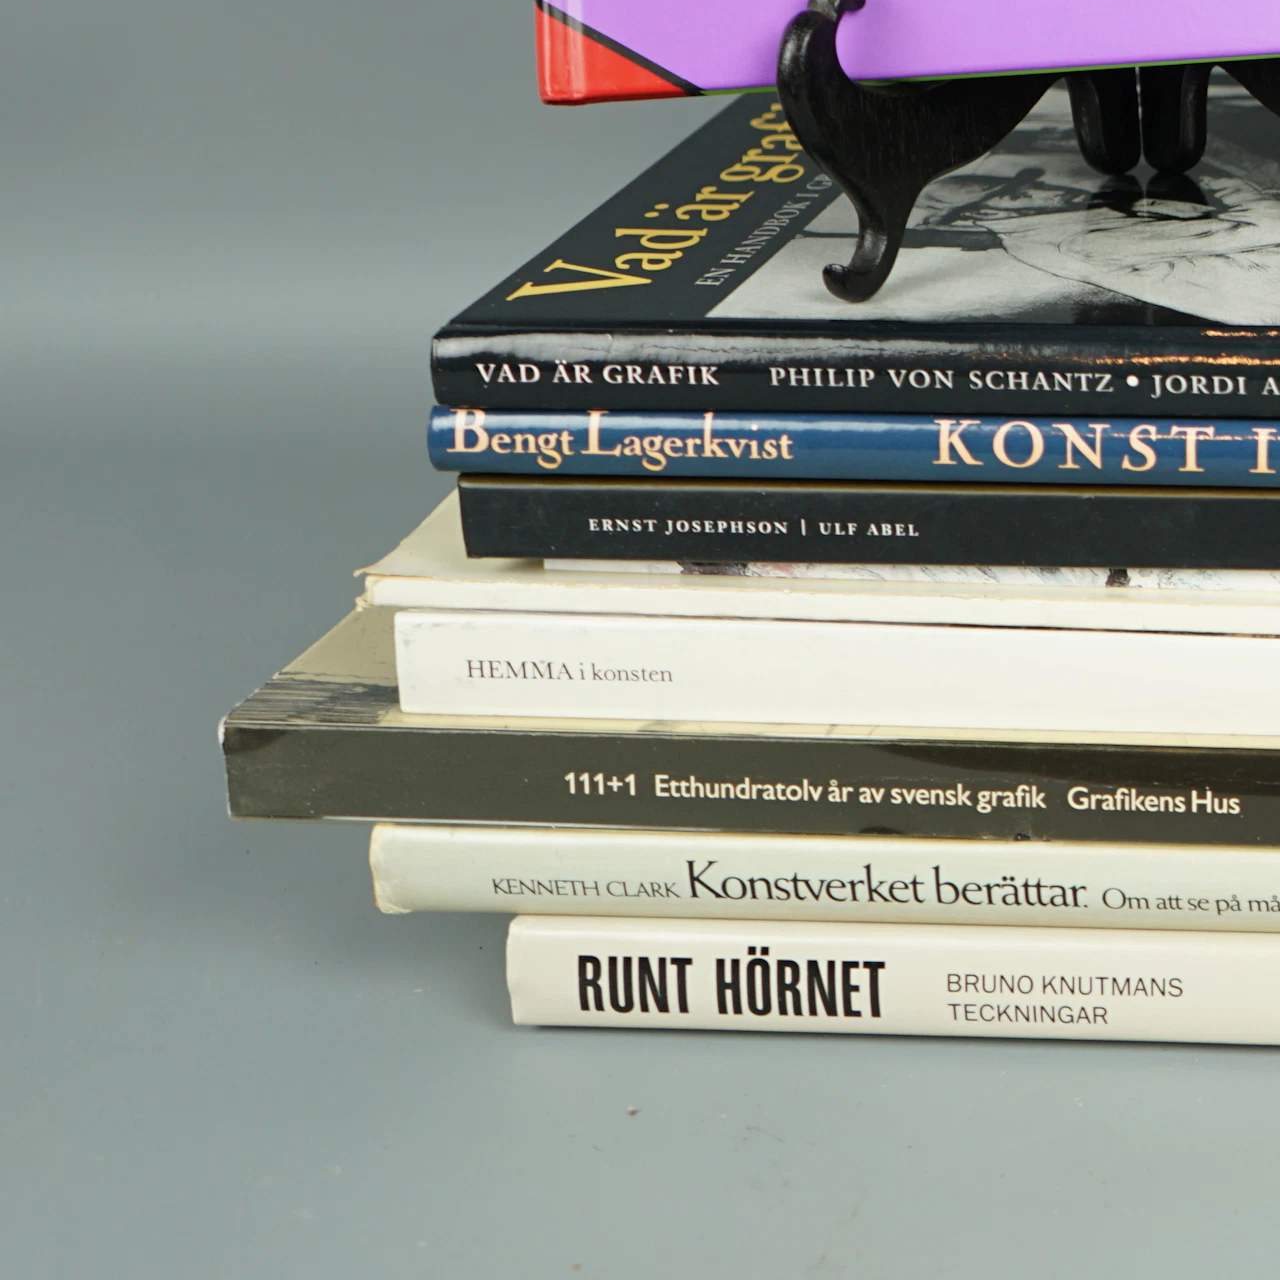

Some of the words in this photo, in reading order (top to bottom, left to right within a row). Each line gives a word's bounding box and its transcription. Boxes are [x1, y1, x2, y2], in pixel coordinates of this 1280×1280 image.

[506, 227, 708, 301] Vad
[644, 186, 755, 222] är
[694, 267, 737, 287] EN
[720, 201, 812, 265] HANDBOK
[476, 363, 540, 384] VAD
[552, 359, 594, 385] ÄR
[603, 365, 720, 387] GRAFIK
[769, 366, 876, 388] PHILIP
[887, 369, 954, 390] VON
[968, 370, 1114, 393] SCHANTZ
[1151, 373, 1247, 398] JORDI
[446, 407, 574, 470] Bengt
[580, 410, 794, 471] Lagerkvist
[933, 418, 1216, 473] KONST
[1249, 426, 1277, 474] I
[588, 517, 657, 534] ERNST
[664, 517, 789, 536] JOSEPHSON
[819, 521, 859, 537] ULF
[866, 521, 920, 537] ABEL
[466, 659, 574, 682] HEMMA
[592, 664, 674, 684] konsten
[564, 772, 637, 797] 111+1
[654, 773, 822, 803] Etthundratolv
[827, 779, 855, 804] år
[859, 787, 886, 805] av
[890, 783, 972, 809] svensk
[977, 784, 1046, 814] grafik
[1067, 786, 1185, 814] Grafikens
[1191, 788, 1241, 816] Hus
[492, 877, 601, 898] KENNETH
[606, 879, 680, 899] CLARK
[685, 860, 925, 905] Konstverket
[1102, 887, 1151, 912] Om
[1155, 890, 1184, 913] att
[1188, 897, 1210, 913] se
[1215, 890, 1242, 920] på
[577, 955, 693, 1016] RUNT
[716, 946, 885, 1018] HÖRNET
[947, 973, 1034, 995] BRUNO
[1041, 976, 1183, 998] KNUTMANS
[947, 1002, 1109, 1026] TECKNINGAR
